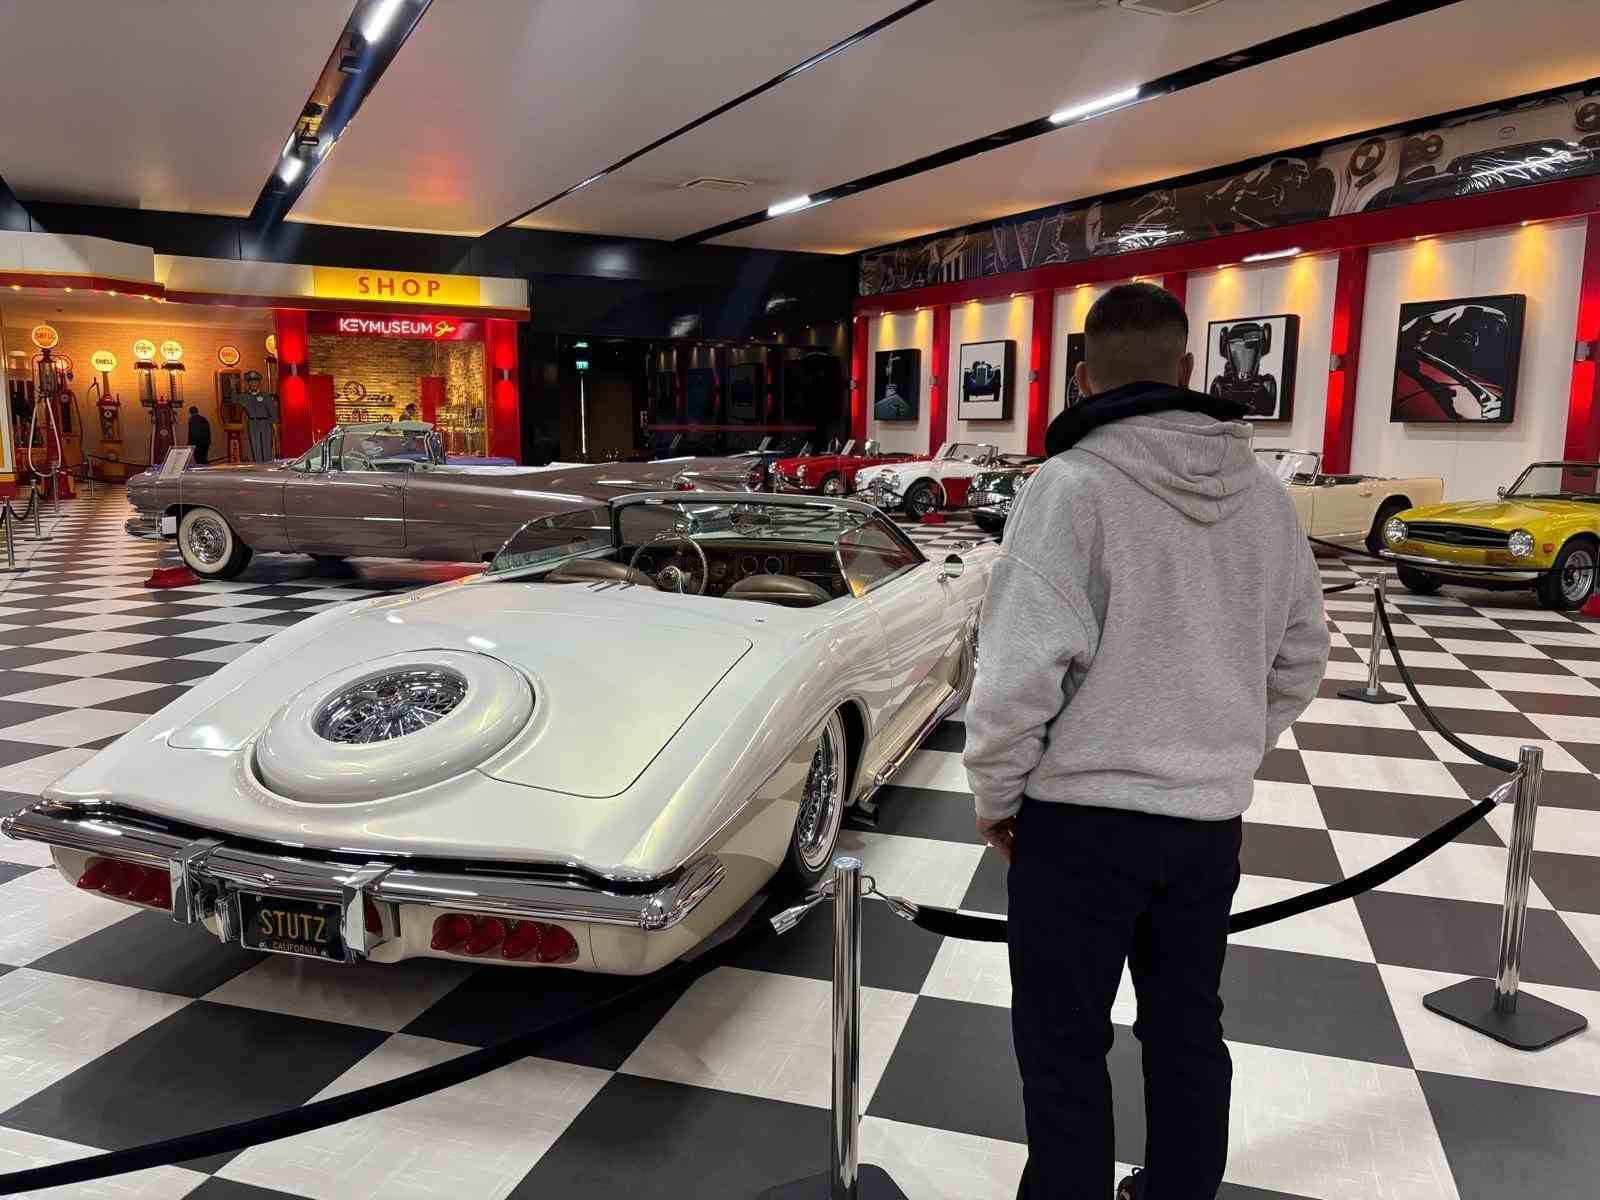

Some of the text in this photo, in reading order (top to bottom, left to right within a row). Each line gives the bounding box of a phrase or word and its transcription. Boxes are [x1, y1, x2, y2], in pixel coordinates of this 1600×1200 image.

[358, 276, 441, 298] SHOP
[339, 318, 433, 334] KEYMUSEUM
[260, 908, 328, 944] STUTZ
[272, 942, 319, 955] CALIFORNIA
